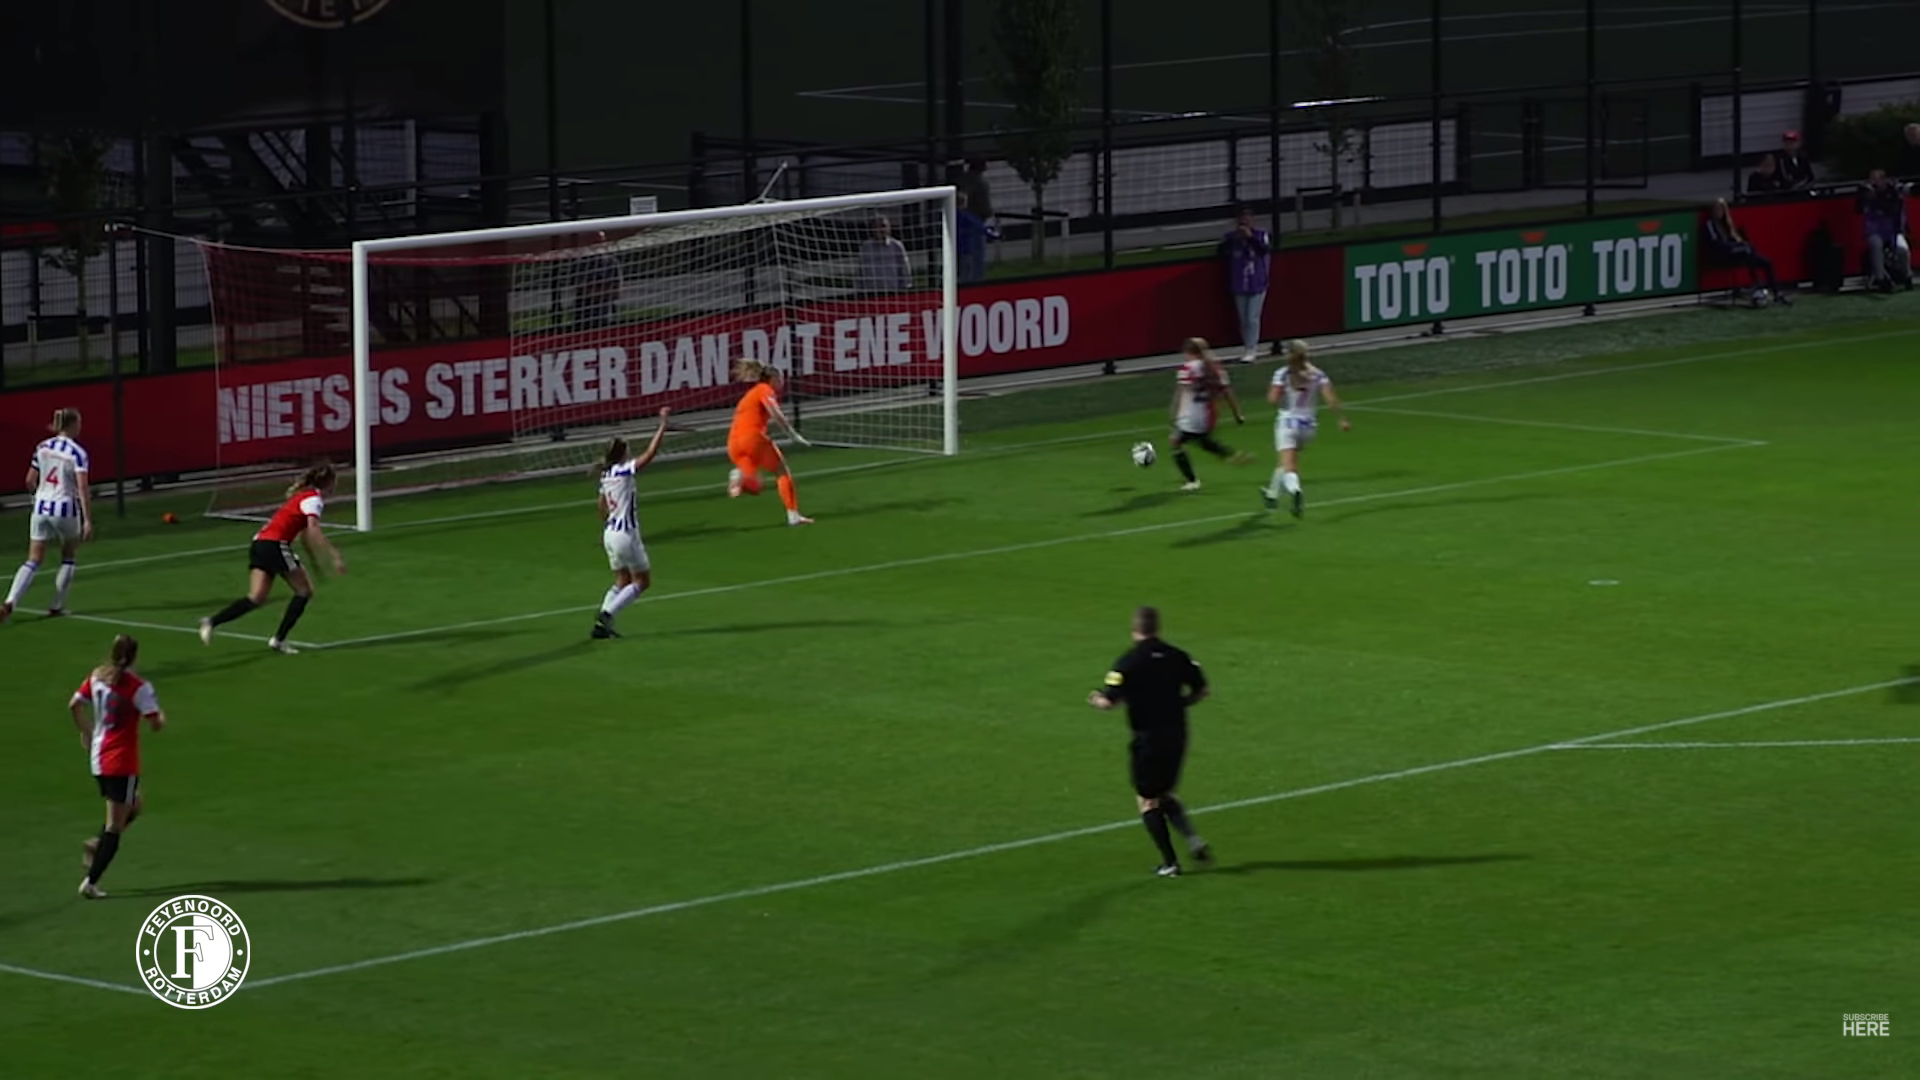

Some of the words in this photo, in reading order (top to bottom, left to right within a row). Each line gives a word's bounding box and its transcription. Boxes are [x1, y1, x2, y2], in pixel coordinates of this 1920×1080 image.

[1354, 256, 1451, 323] TOTO
[1475, 243, 1569, 308] TOTO
[1593, 233, 1684, 296] TOTO
[219, 373, 352, 445] NIETS
[368, 366, 412, 426] IS
[424, 345, 629, 421] STERKER
[639, 331, 730, 396] DAN
[741, 322, 821, 379] DAT
[833, 311, 913, 373] ENE
[921, 294, 1071, 361] WOORD
[45, 466, 60, 489] 4
